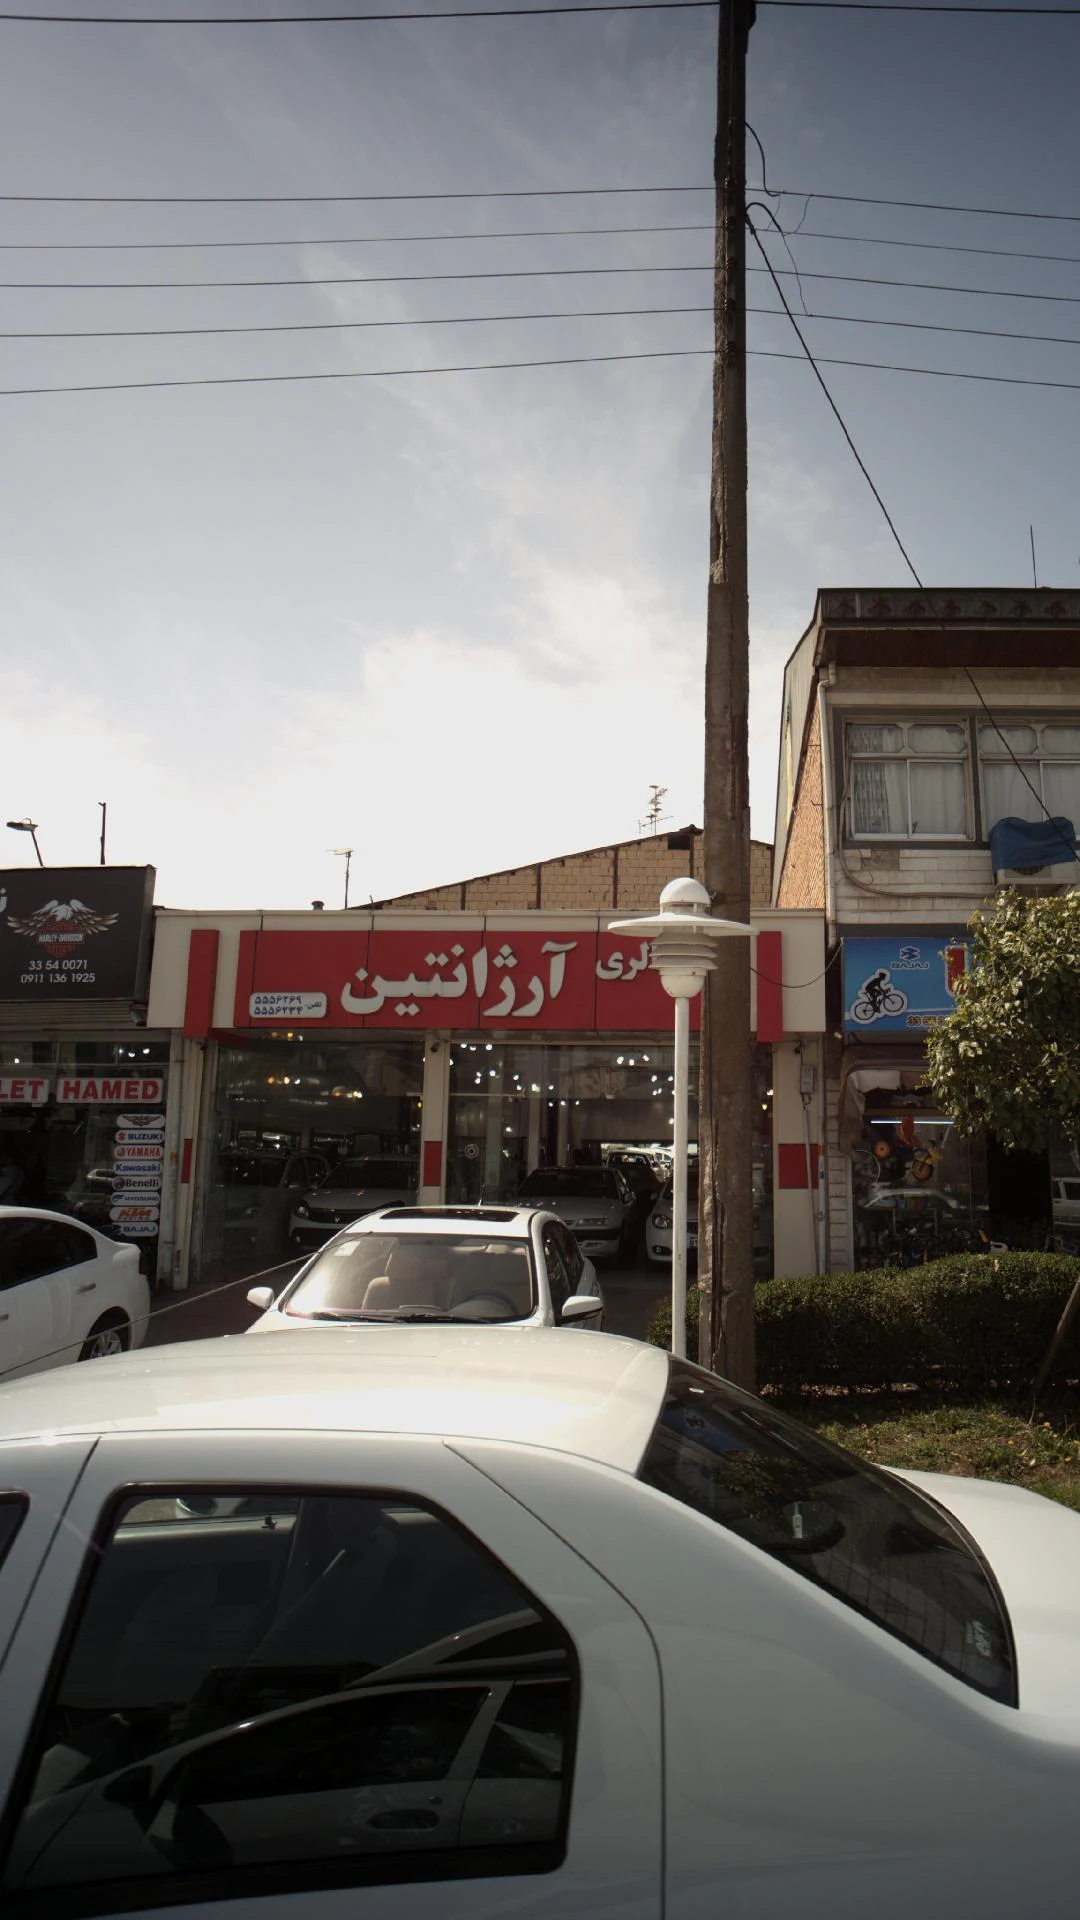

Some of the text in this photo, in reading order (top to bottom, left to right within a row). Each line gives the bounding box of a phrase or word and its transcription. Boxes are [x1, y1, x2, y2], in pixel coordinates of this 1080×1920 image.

[29, 959, 87, 970] 33 54 0071
[21, 973, 95, 984] 0911 136 1925
[341, 940, 577, 1017] آرژانتین
[908, 1015, 921, 1026] 33
[63, 1080, 159, 1099] HAMED
[126, 1147, 160, 1157] YAMAHA
[115, 1163, 160, 1172] Kawasaki
[126, 1179, 159, 1187] Benelli
